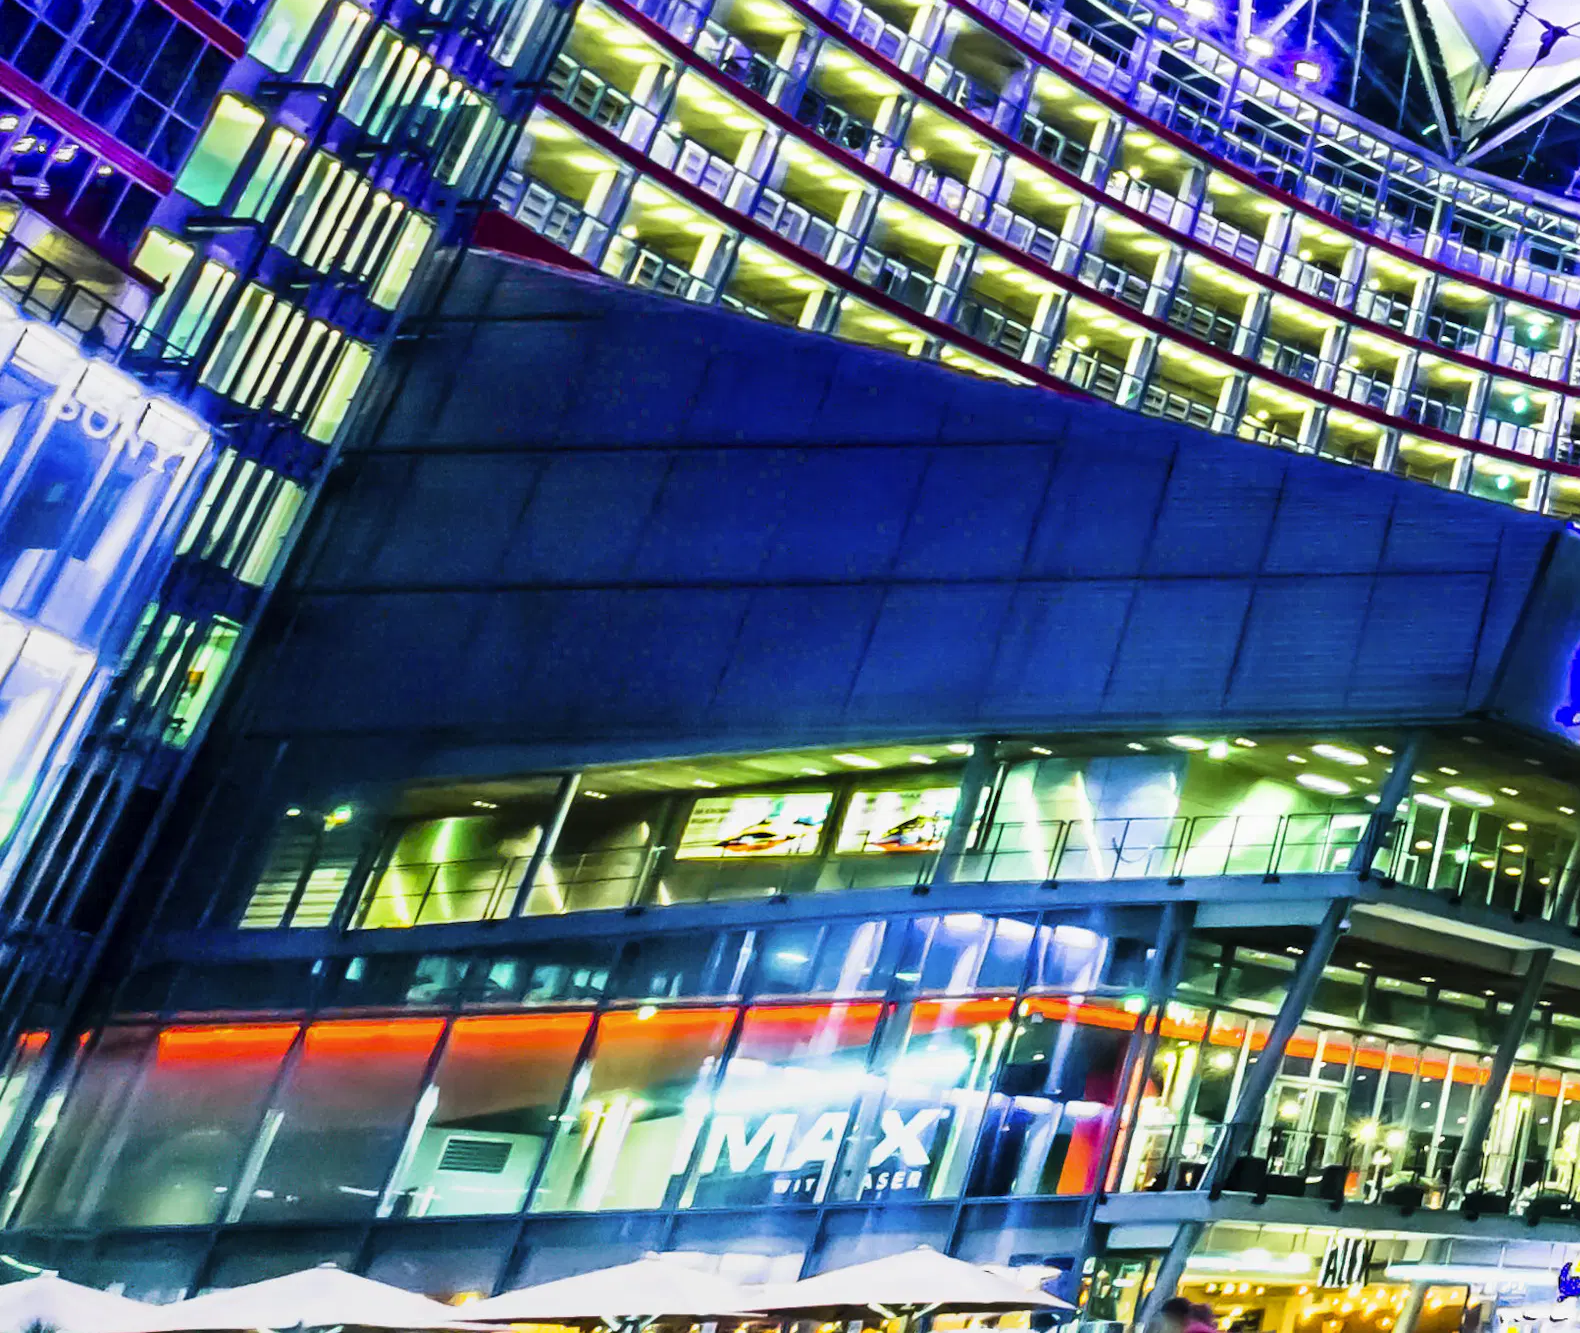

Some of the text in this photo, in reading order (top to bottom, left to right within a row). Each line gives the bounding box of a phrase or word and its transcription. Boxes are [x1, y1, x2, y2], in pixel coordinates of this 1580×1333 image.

[672, 1108, 941, 1176] IMAX
[773, 1170, 922, 1194] WIT ASER
